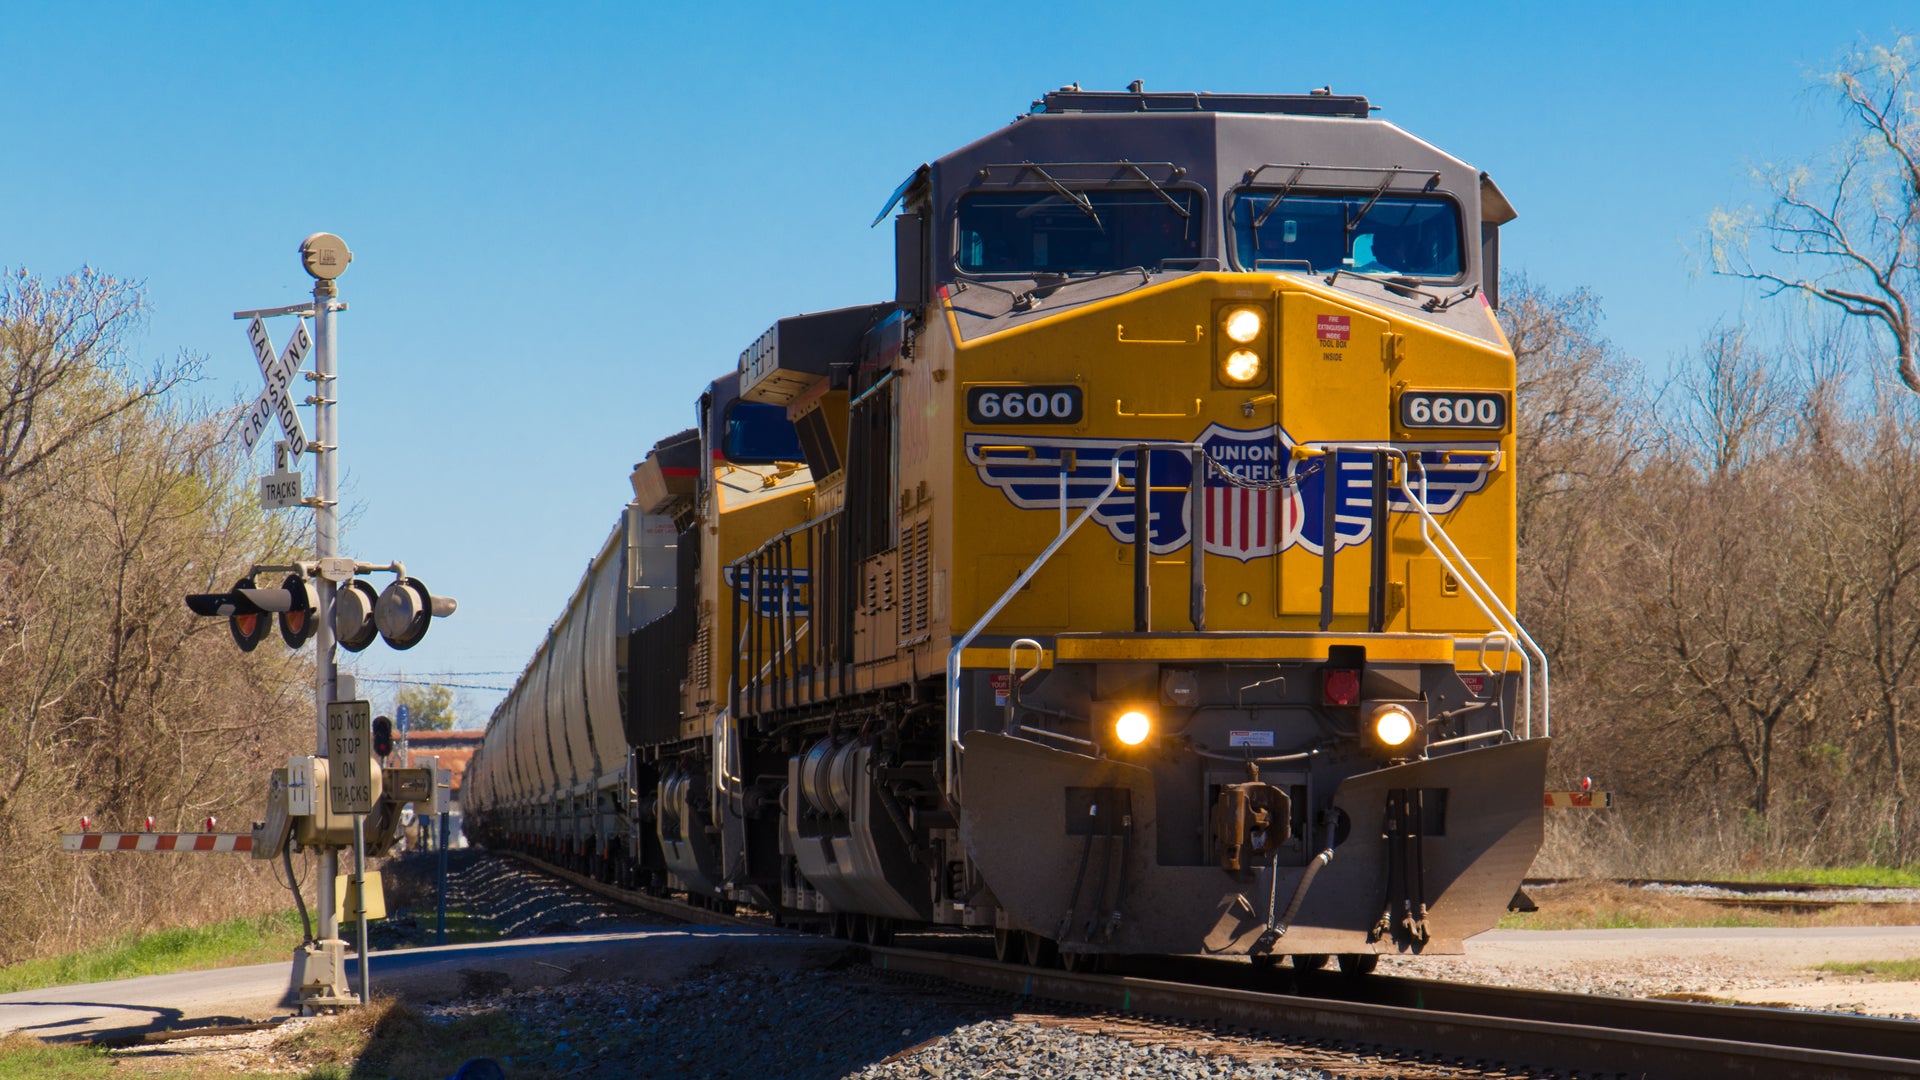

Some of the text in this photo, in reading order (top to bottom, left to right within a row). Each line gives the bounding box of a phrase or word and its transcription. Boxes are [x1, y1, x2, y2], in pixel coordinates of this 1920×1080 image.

[1317, 324, 1350, 332] EXTINGUISHER
[1319, 339, 1347, 348] TOOL BOX
[1323, 352, 1343, 361] INSIDE
[243, 329, 307, 448] CROSSING
[978, 392, 1072, 418] 6600
[1410, 397, 1497, 423] 6600
[277, 443, 285, 469] 2
[1212, 445, 1278, 461] UNION
[266, 480, 297, 501] TRACKS
[330, 713, 366, 731] DO NOT
[336, 738, 361, 755] STOP
[342, 761, 356, 778] ON
[332, 785, 369, 803] TRACKS
